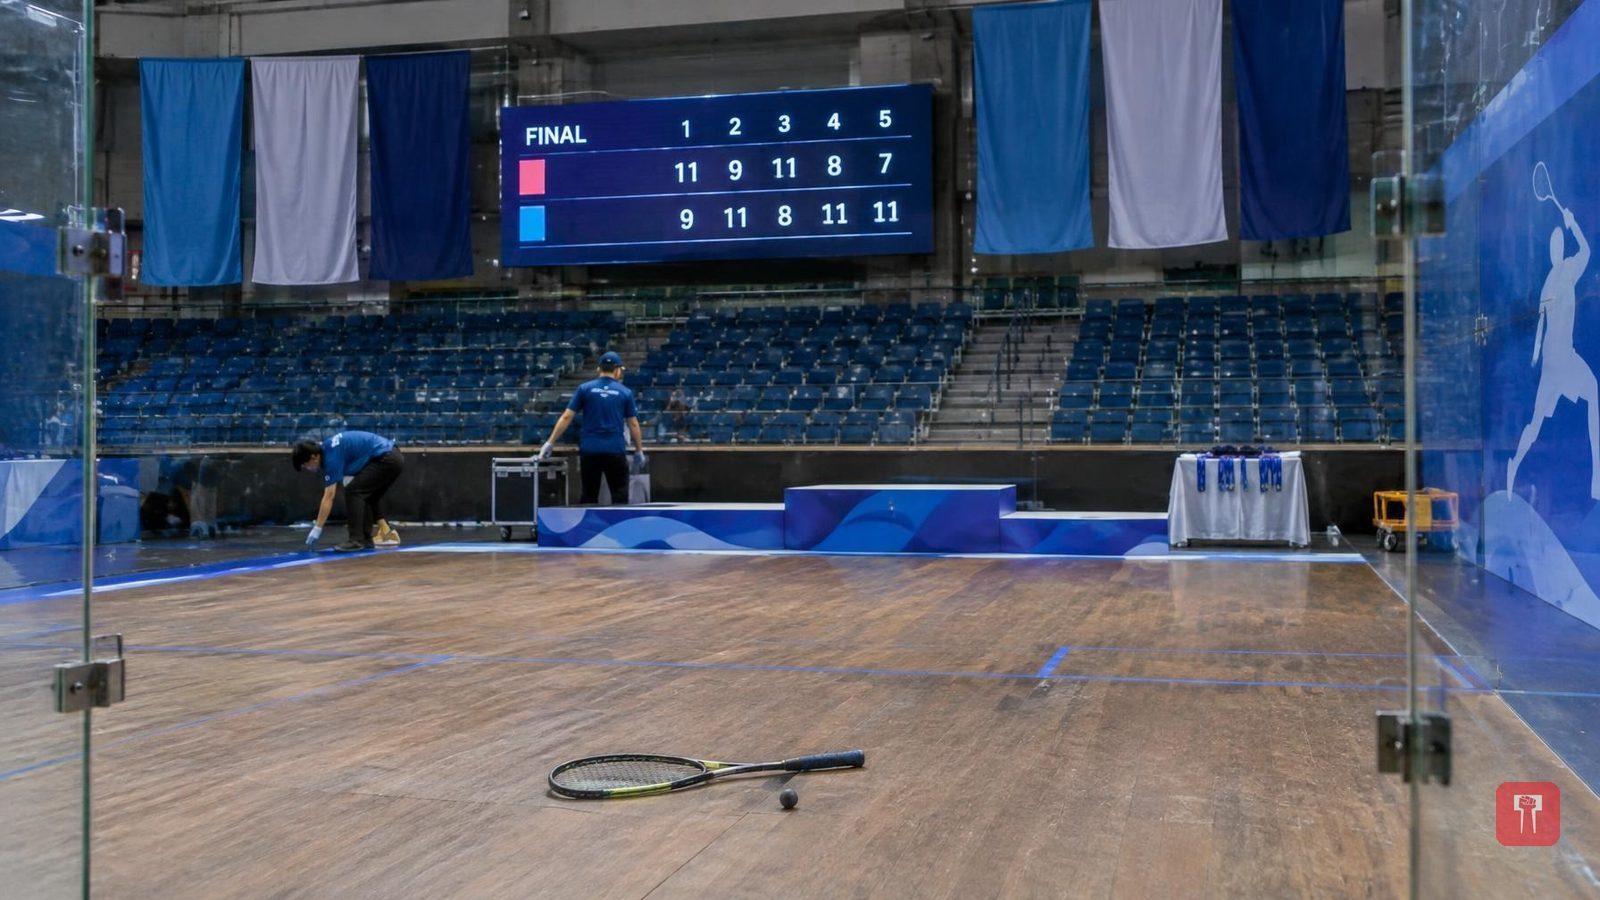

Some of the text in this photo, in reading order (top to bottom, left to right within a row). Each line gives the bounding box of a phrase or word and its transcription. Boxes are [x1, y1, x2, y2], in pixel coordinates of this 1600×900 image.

[525, 109, 892, 146] FINAL 1 2 3 4 5
[674, 152, 892, 183] 11 9 11 8 7
[679, 200, 898, 230] 9 11 8 11 11
